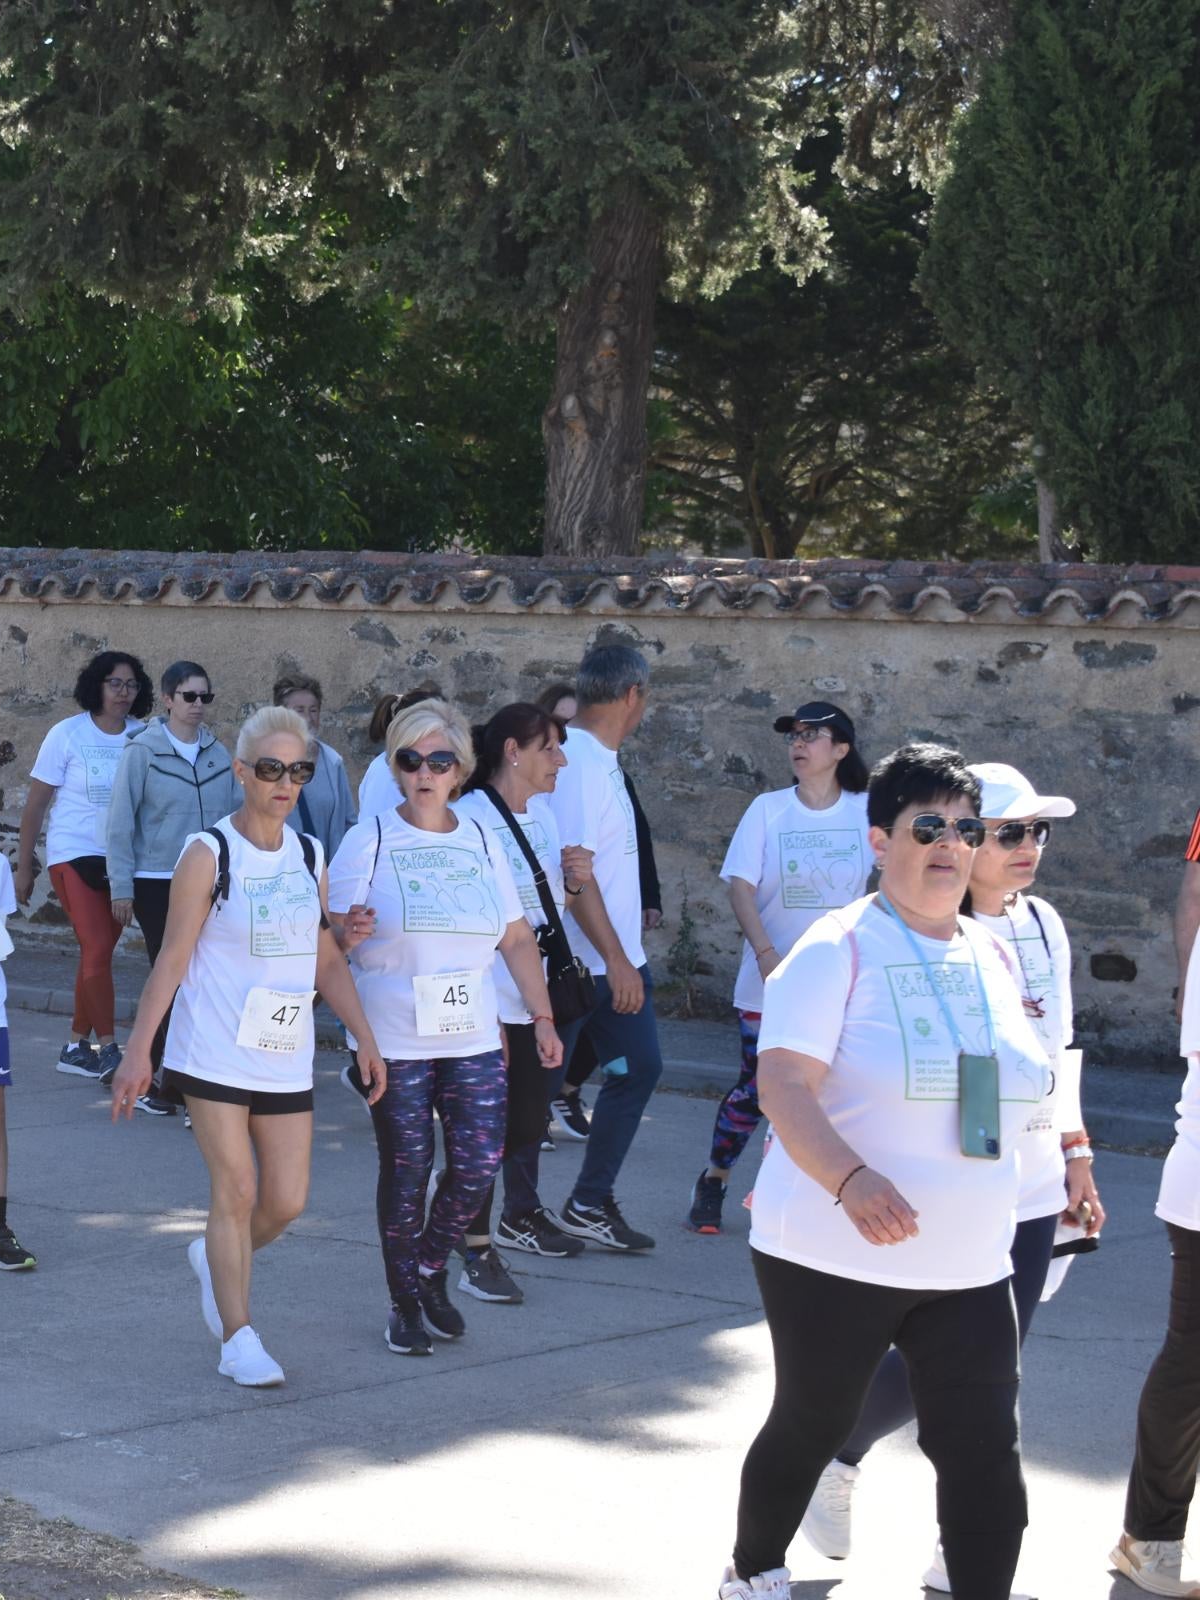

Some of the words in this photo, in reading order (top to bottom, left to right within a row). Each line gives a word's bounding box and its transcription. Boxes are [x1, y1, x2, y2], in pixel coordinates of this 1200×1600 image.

[397, 854, 406, 862] IX
[412, 850, 448, 861] PASEO
[400, 859, 456, 872] SALUDABLE
[895, 972, 910, 986] IX
[915, 970, 965, 984] PASEO
[443, 984, 468, 1006] 45
[900, 984, 978, 998] SALUDABLE
[271, 1006, 300, 1026] 47
